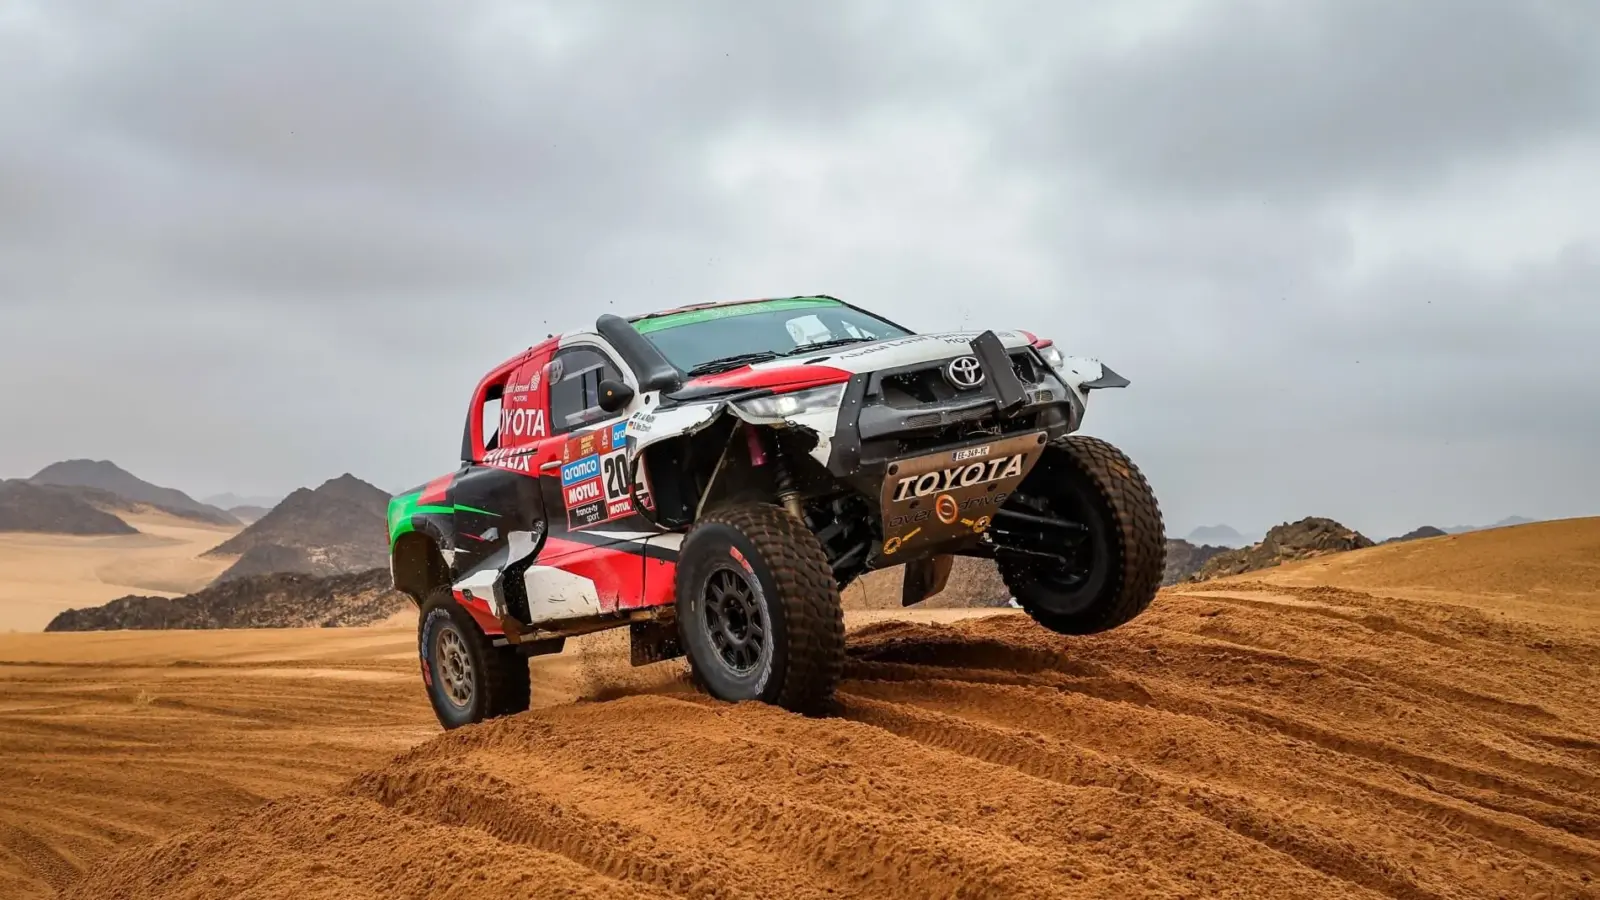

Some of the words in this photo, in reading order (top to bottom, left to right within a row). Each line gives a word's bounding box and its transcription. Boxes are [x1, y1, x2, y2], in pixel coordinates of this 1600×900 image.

[500, 408, 545, 437] OYOTA
[613, 430, 626, 441] ara
[564, 459, 597, 481] aramco
[604, 453, 644, 499] 20
[895, 453, 1022, 502] TOYOTA
[569, 481, 600, 504] MOTUL
[586, 512, 600, 523] sport
[610, 501, 631, 515] MOTUL
